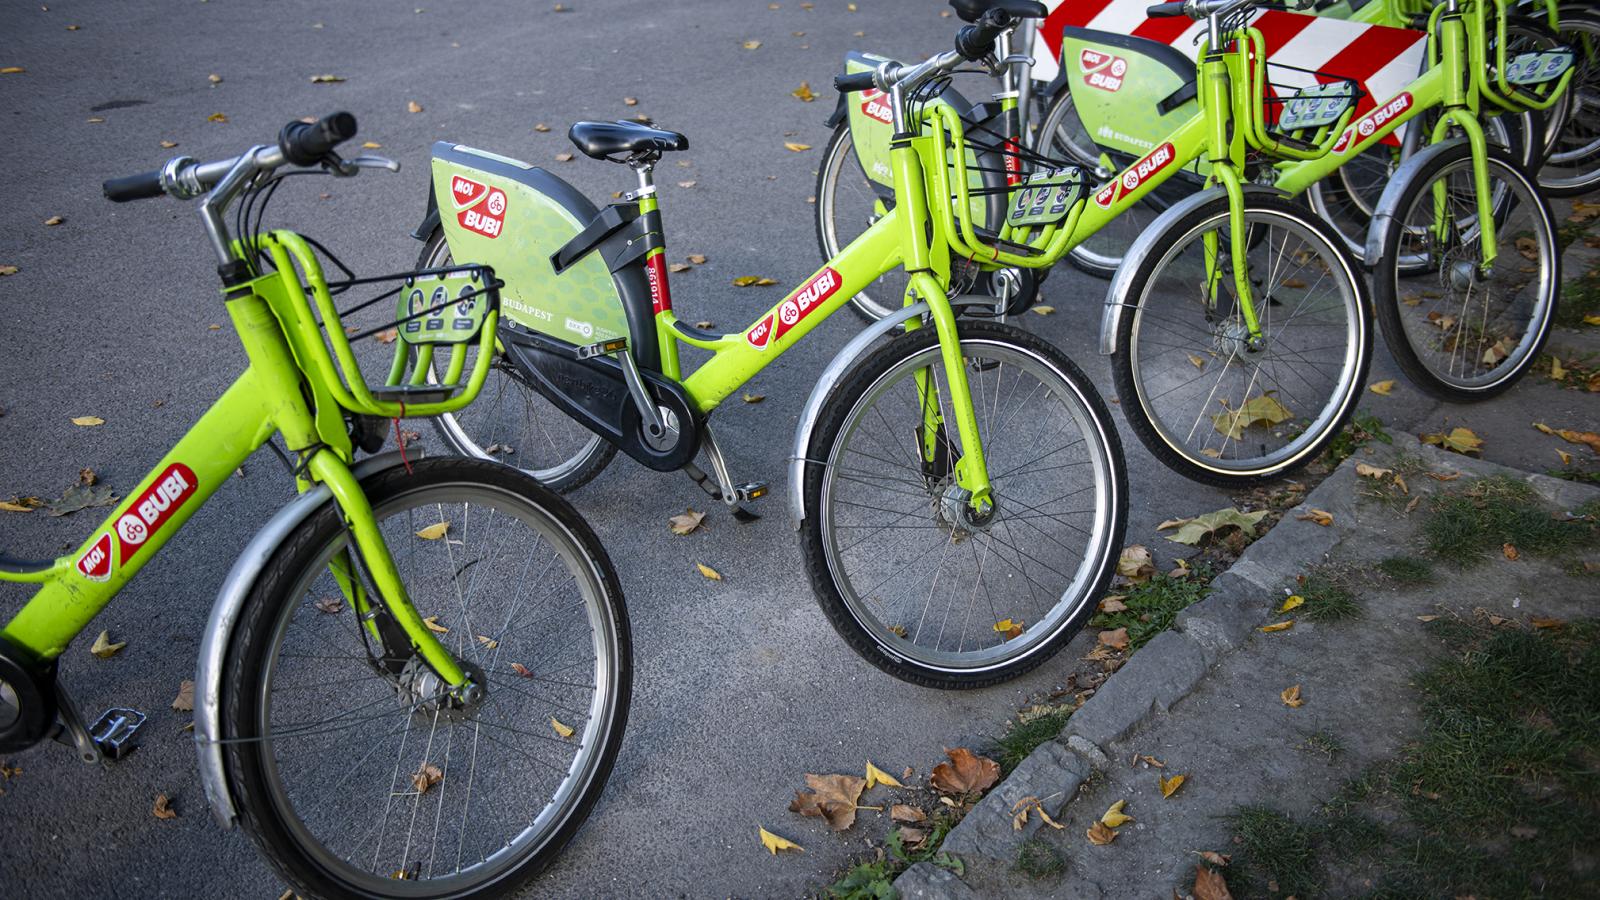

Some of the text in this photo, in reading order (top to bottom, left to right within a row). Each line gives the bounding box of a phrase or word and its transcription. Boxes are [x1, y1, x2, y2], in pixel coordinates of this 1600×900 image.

[1083, 51, 1101, 64] MOL
[1089, 72, 1121, 91] BUBI
[1374, 95, 1408, 126] BUBI
[454, 180, 474, 196] MOL
[1099, 146, 1170, 203] MOL BUBI
[464, 209, 502, 236] BUBI
[648, 267, 659, 304] 861014
[502, 296, 554, 322] BUDAPEST
[750, 271, 836, 343] MOL BUBI
[83, 469, 190, 573] MOL BUBI
